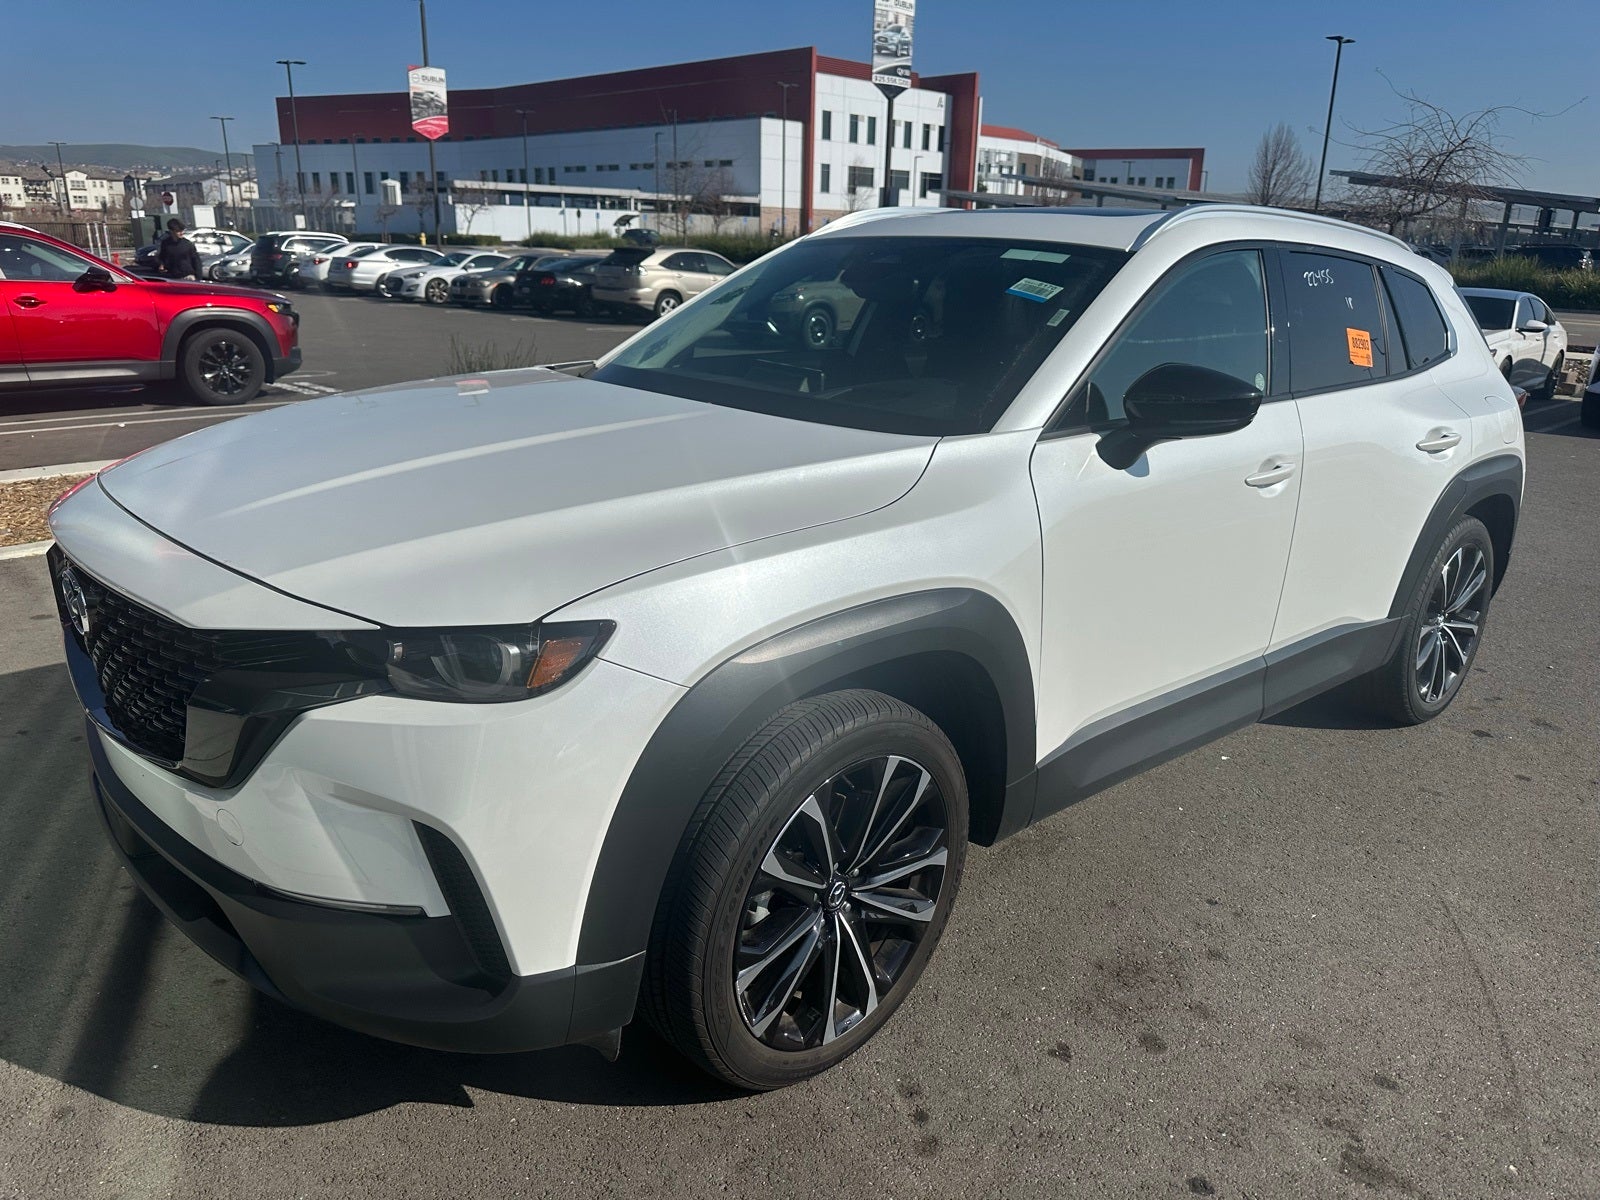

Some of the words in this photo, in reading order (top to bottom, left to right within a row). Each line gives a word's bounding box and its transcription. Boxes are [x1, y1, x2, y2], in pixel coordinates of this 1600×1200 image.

[421, 75, 445, 83] DUBLIN
[1303, 268, 1334, 287] 22455
[1352, 337, 1370, 350] 882903
